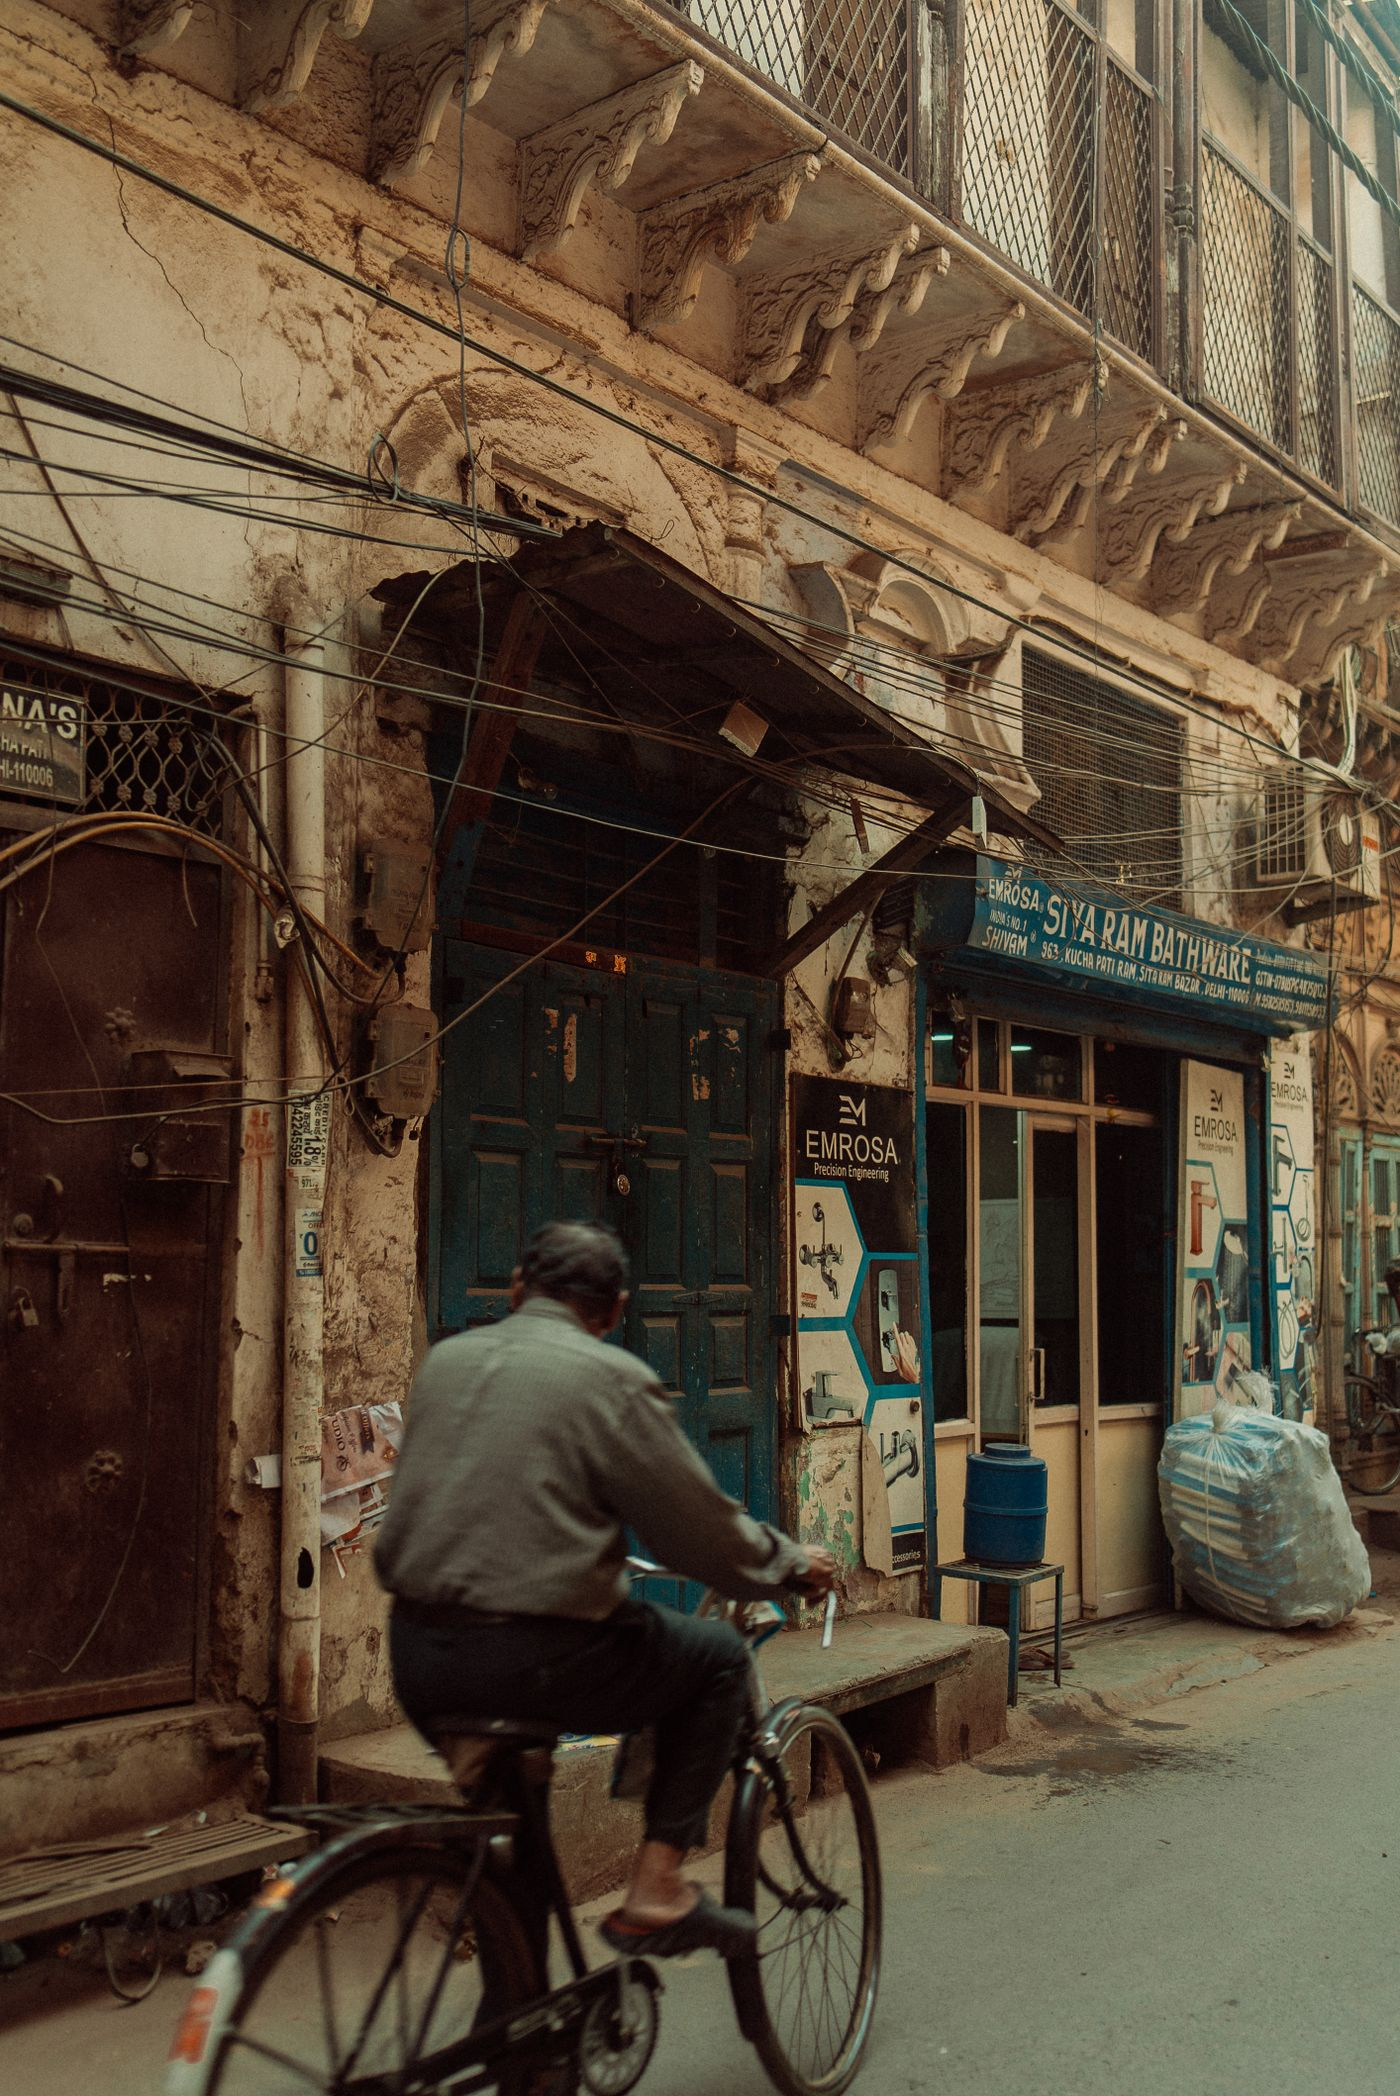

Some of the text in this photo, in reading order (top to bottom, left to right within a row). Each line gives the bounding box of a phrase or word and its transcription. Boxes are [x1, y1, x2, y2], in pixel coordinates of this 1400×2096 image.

[988, 878, 1039, 911] EMROSA
[982, 925, 1028, 957] SHIVAM
[1043, 894, 1096, 947] SIYA
[1100, 910, 1149, 960] RAM
[1149, 921, 1251, 985] BATHWARE
[1065, 947, 1094, 970] KUCHA
[1096, 955, 1116, 976] PATI
[1270, 1081, 1308, 1103] EMROSA
[291, 1098, 304, 1167] 042245595
[1194, 1115, 1238, 1142] EMROSA
[806, 1129, 898, 1165] EMROSA
[814, 1161, 889, 1183] Precision Engineering
